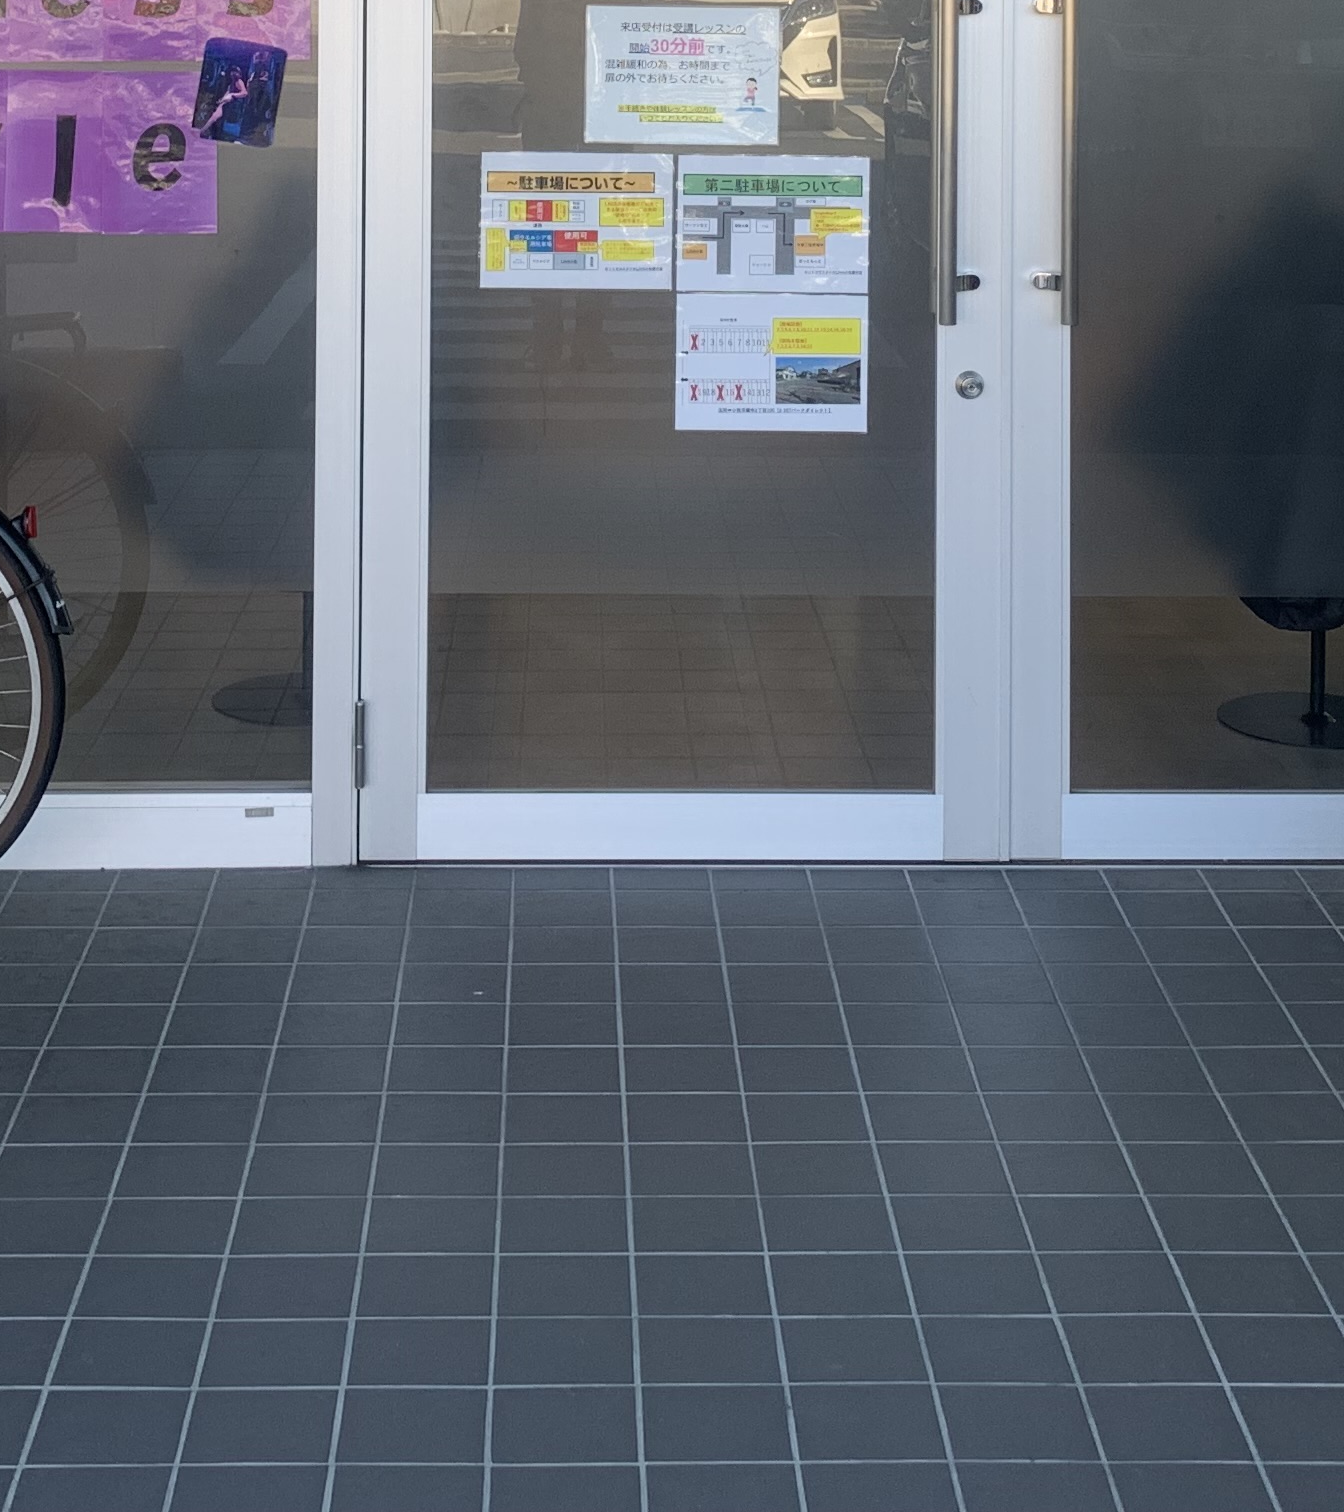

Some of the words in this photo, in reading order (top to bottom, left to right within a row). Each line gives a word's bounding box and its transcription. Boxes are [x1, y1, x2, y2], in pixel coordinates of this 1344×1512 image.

[629, 39, 732, 55] 開始30分前です。
[605, 73, 725, 85] 扉の外でお待ちください。
[704, 178, 841, 194] 第二駐車場について
[564, 231, 588, 240] 使用可
